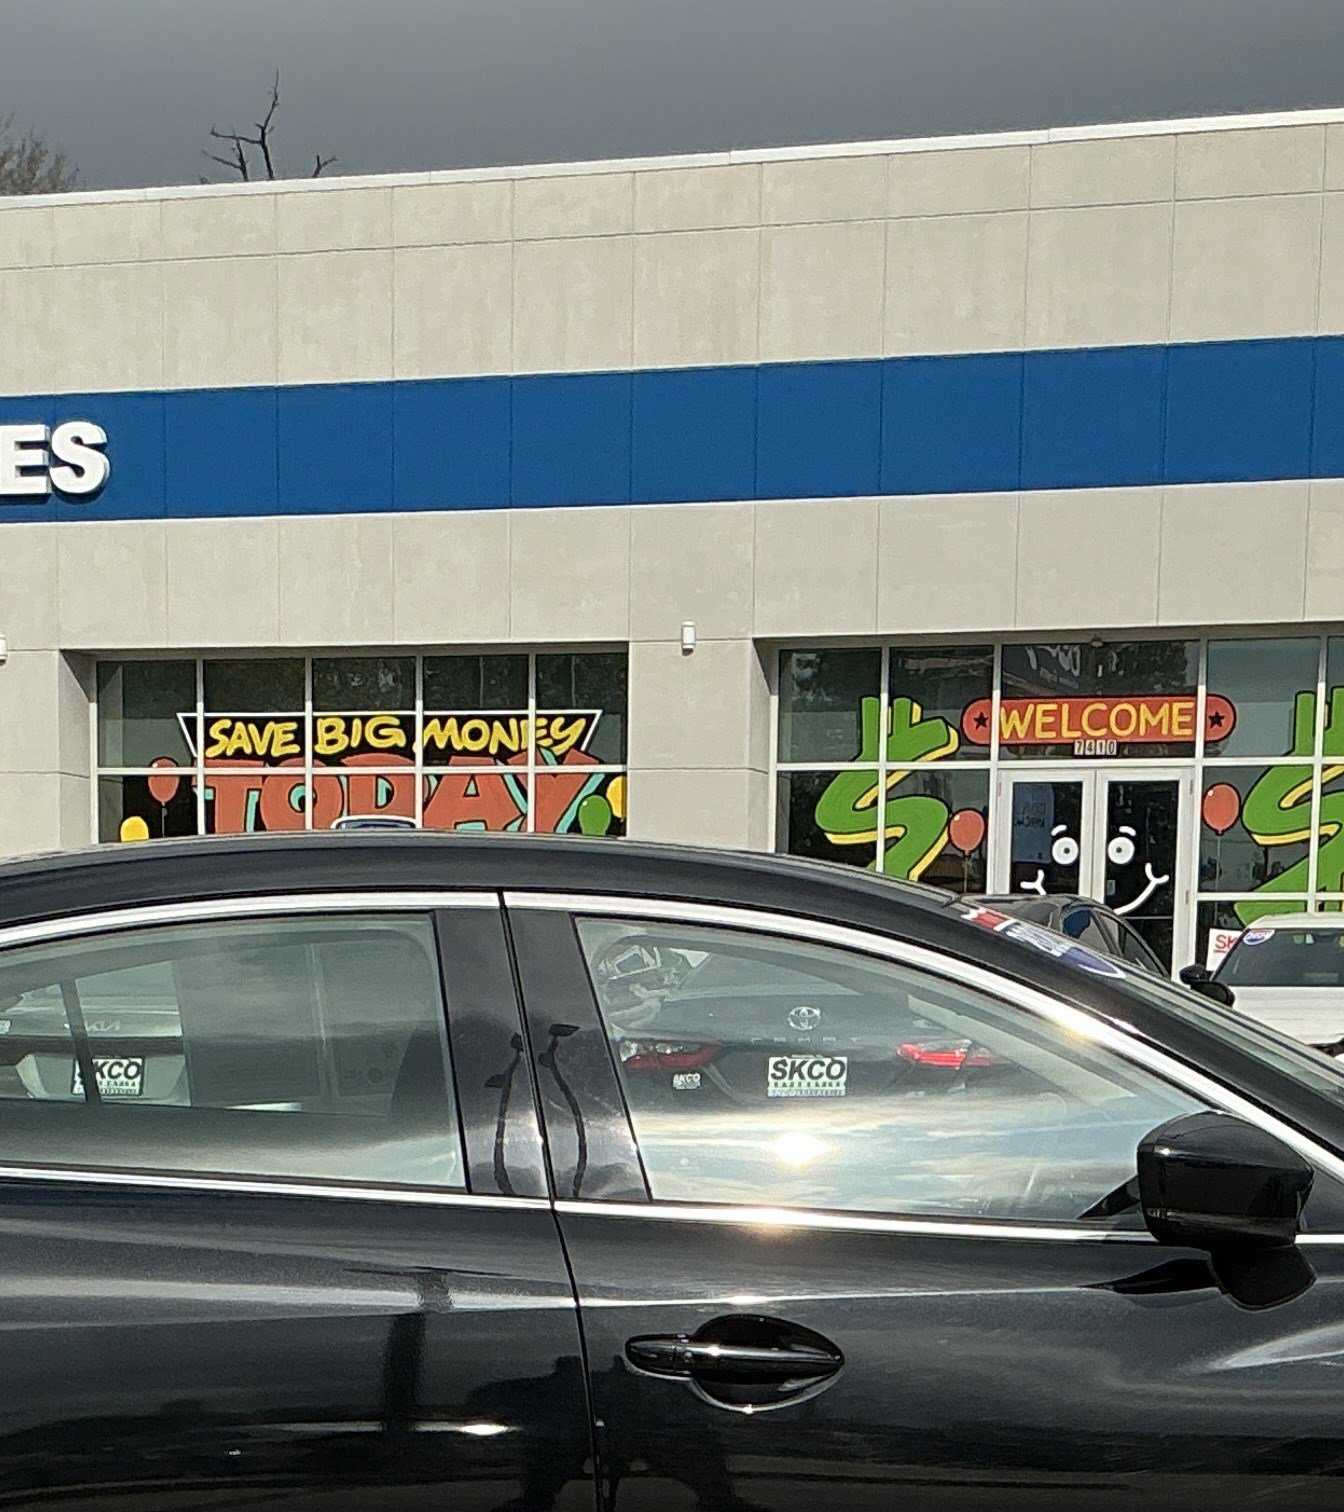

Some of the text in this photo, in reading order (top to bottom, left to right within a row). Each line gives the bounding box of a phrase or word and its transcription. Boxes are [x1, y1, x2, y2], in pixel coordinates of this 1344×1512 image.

[205, 715, 587, 757] SAVE BIG MONEY
[999, 701, 1195, 739] WELCOME
[1075, 740, 1117, 755] 7410
[201, 751, 602, 833] TODAY
[770, 1058, 847, 1081] SKCO
